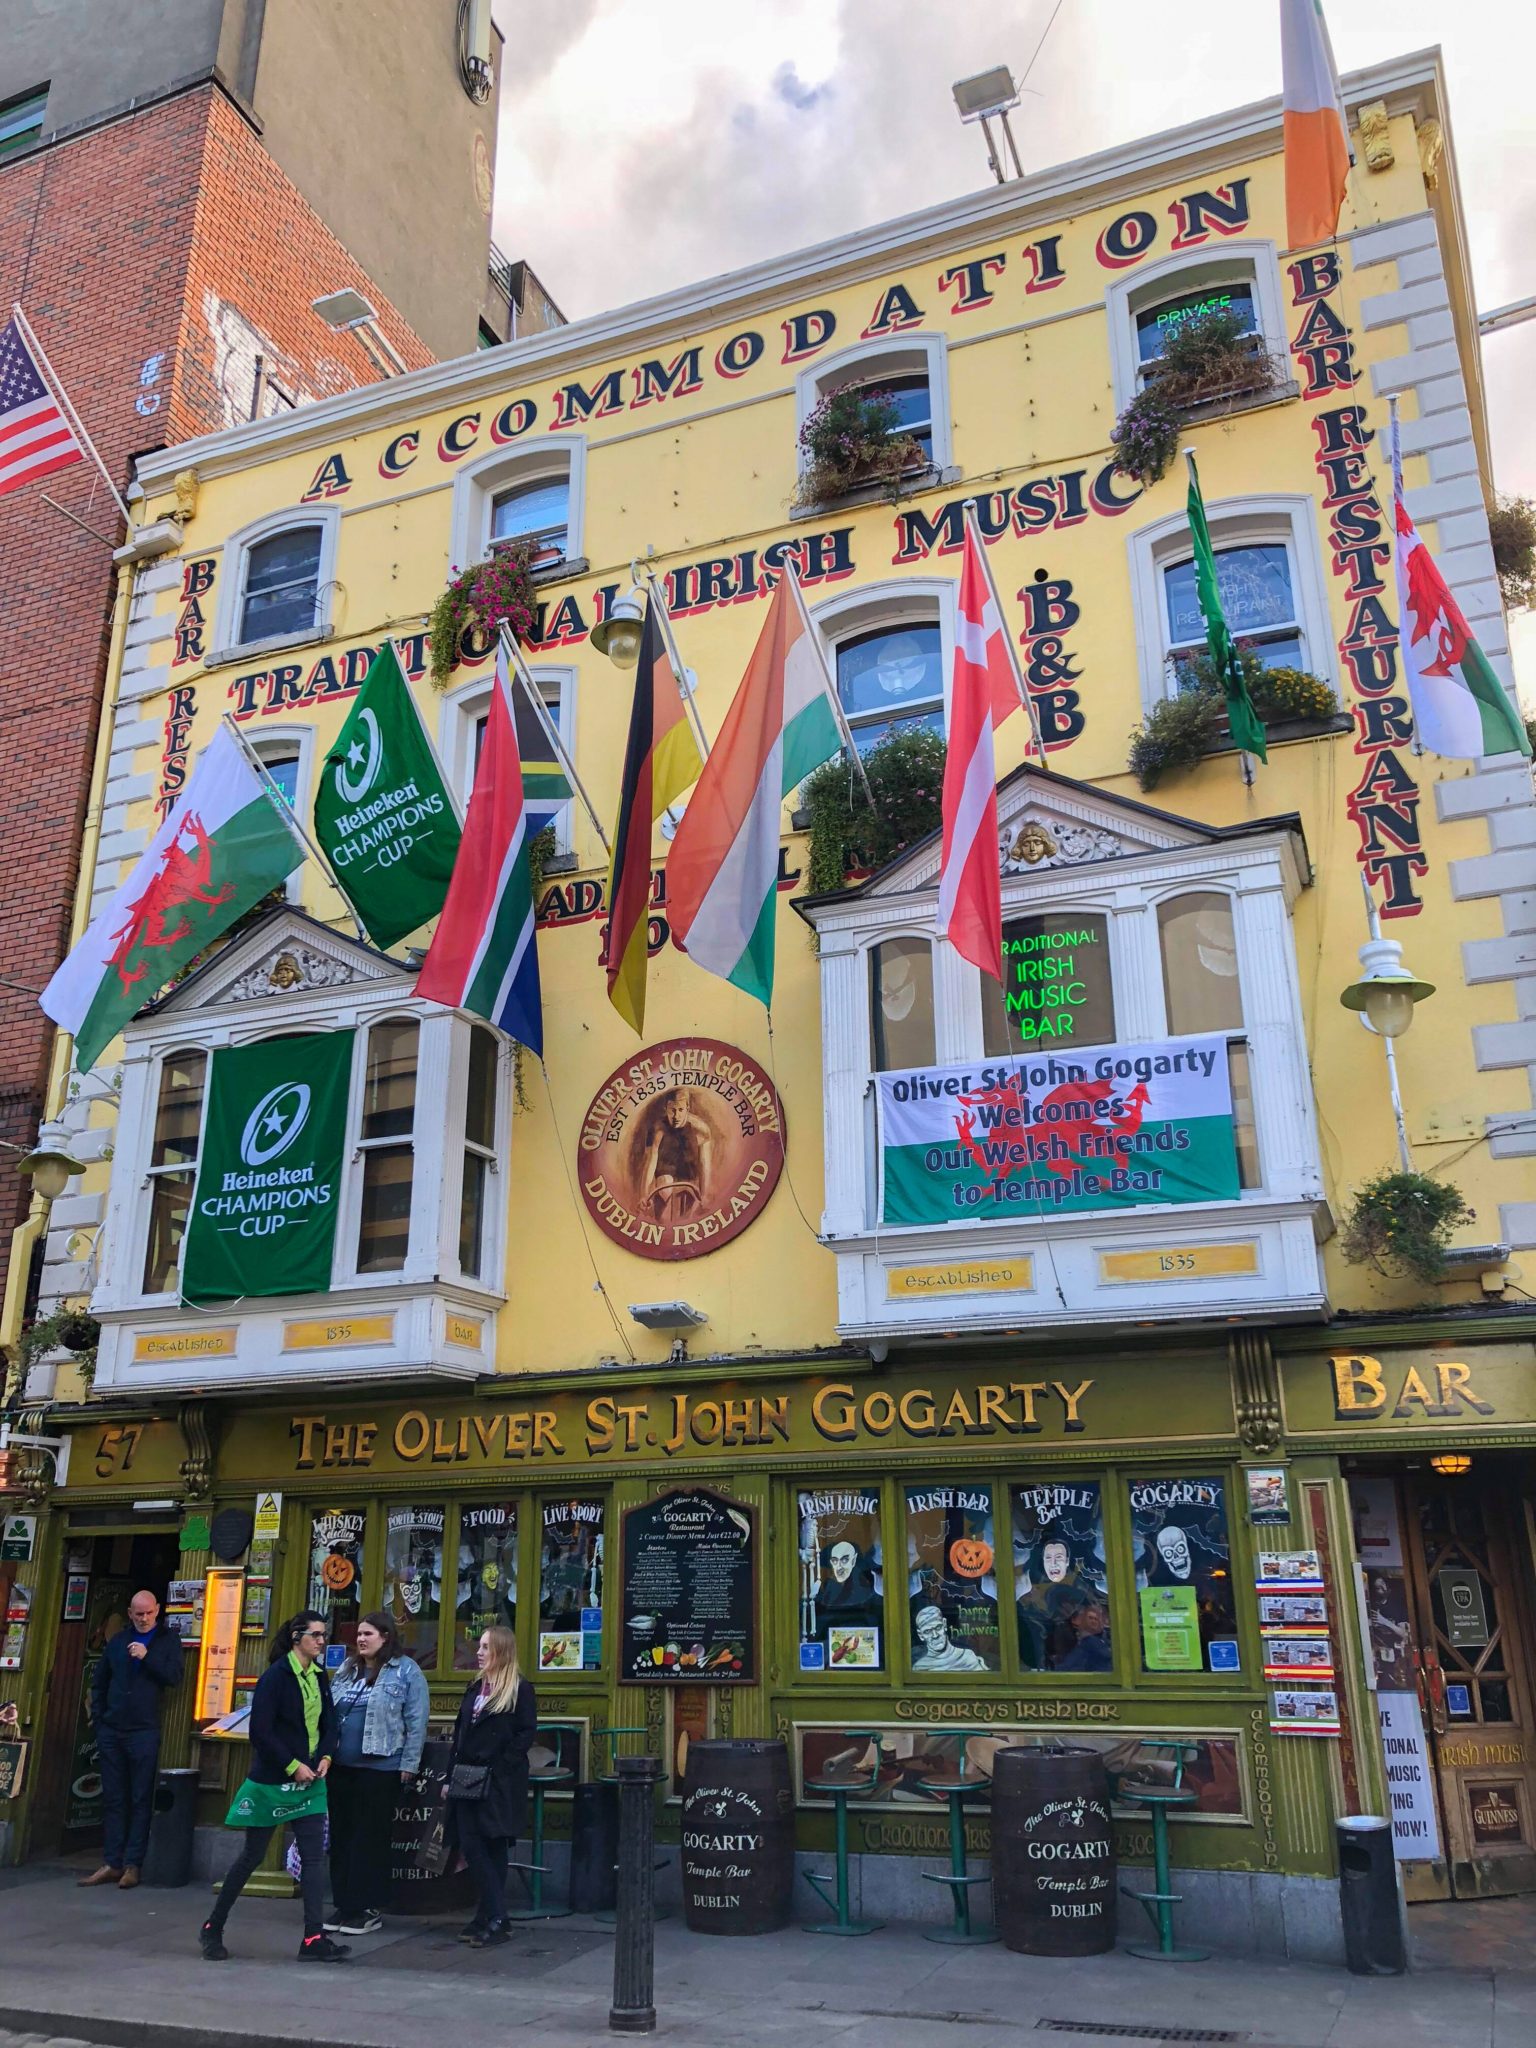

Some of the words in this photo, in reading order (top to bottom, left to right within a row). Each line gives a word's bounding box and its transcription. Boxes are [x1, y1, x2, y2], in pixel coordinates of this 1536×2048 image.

[1157, 295, 1232, 329] PRIVATE
[300, 176, 1252, 503] ACCOMMODATION
[1288, 253, 1362, 401] BAR
[666, 527, 857, 620] IRISH
[892, 460, 1144, 565] MUSIC
[172, 558, 217, 668] BAR
[1019, 578, 1086, 754] B&B
[1312, 405, 1429, 920] RESTAURANT
[334, 782, 420, 838] Heineken
[332, 792, 444, 867] CHAMPIONS
[377, 835, 414, 868] CUP
[1000, 930, 1099, 956] RADITIONAL
[1016, 956, 1075, 983] IRISH
[1006, 982, 1088, 1013] MUSIC
[1021, 1013, 1074, 1041] BAR
[893, 1074, 972, 1104] Oliver
[1095, 1048, 1217, 1084] Gogarty
[582, 1077, 633, 1151] OLIVER
[629, 1058, 654, 1086] ST
[659, 1049, 714, 1074] JOHN
[716, 1056, 780, 1133] GOGARTY
[606, 1107, 629, 1144] EST
[629, 1077, 667, 1107] 1835
[671, 1071, 739, 1102] TEMPLE
[734, 1099, 756, 1138] BAR
[977, 1096, 1125, 1129] Welcomes
[925, 1147, 973, 1173] Our
[982, 1134, 1069, 1167] Welsh
[1080, 1123, 1191, 1158] Friends
[221, 1165, 315, 1193] Heineken
[953, 1181, 981, 1207] to
[991, 1168, 1101, 1205] Temple
[1110, 1167, 1164, 1193] Bar
[201, 1184, 331, 1217] CHAMPIONS
[585, 1175, 666, 1246] DUBLIN
[672, 1159, 770, 1246] IRELAND
[240, 1215, 285, 1238] CUP
[1158, 1253, 1197, 1272] 1835
[326, 1325, 353, 1342] 1835
[97, 1424, 143, 1477] 57
[800, 1495, 834, 1518] IRISH
[837, 1494, 879, 1515] MUSIC
[907, 1491, 954, 1515] IRISH
[956, 1491, 989, 1514] BAR
[1020, 1488, 1093, 1510] TEMPLE
[1130, 1483, 1223, 1508] GOGARTY
[312, 1514, 366, 1532] WHISKEY
[469, 1508, 506, 1528] FOOD
[543, 1506, 569, 1526] LIVE
[571, 1505, 604, 1523] SPORT
[663, 1512, 714, 1522] GOGARTY
[669, 1523, 706, 1531] Restaurant
[1036, 1505, 1062, 1525] Bar
[895, 1699, 1008, 1722] Gogartys
[1387, 1765, 1422, 1782] MUSIC
[695, 1787, 719, 1800] Oliver
[721, 1786, 734, 1799] St.
[735, 1791, 762, 1817] John
[1024, 1812, 1043, 1833] The
[1043, 1800, 1073, 1816] Oliver
[1075, 1796, 1088, 1809] St.
[1394, 1820, 1428, 1838] NOW!
[1474, 1808, 1518, 1826] GUINNESS
[683, 1831, 759, 1851] GOGARTY
[1028, 1840, 1111, 1860] GOGARTY
[686, 1861, 722, 1879] Temple
[725, 1864, 752, 1879] Bar
[1036, 1876, 1087, 1893] Temple
[1089, 1875, 1109, 1890] Bar
[693, 1894, 741, 1908] DUBLIN
[1050, 1902, 1103, 1918] DUBLIN
